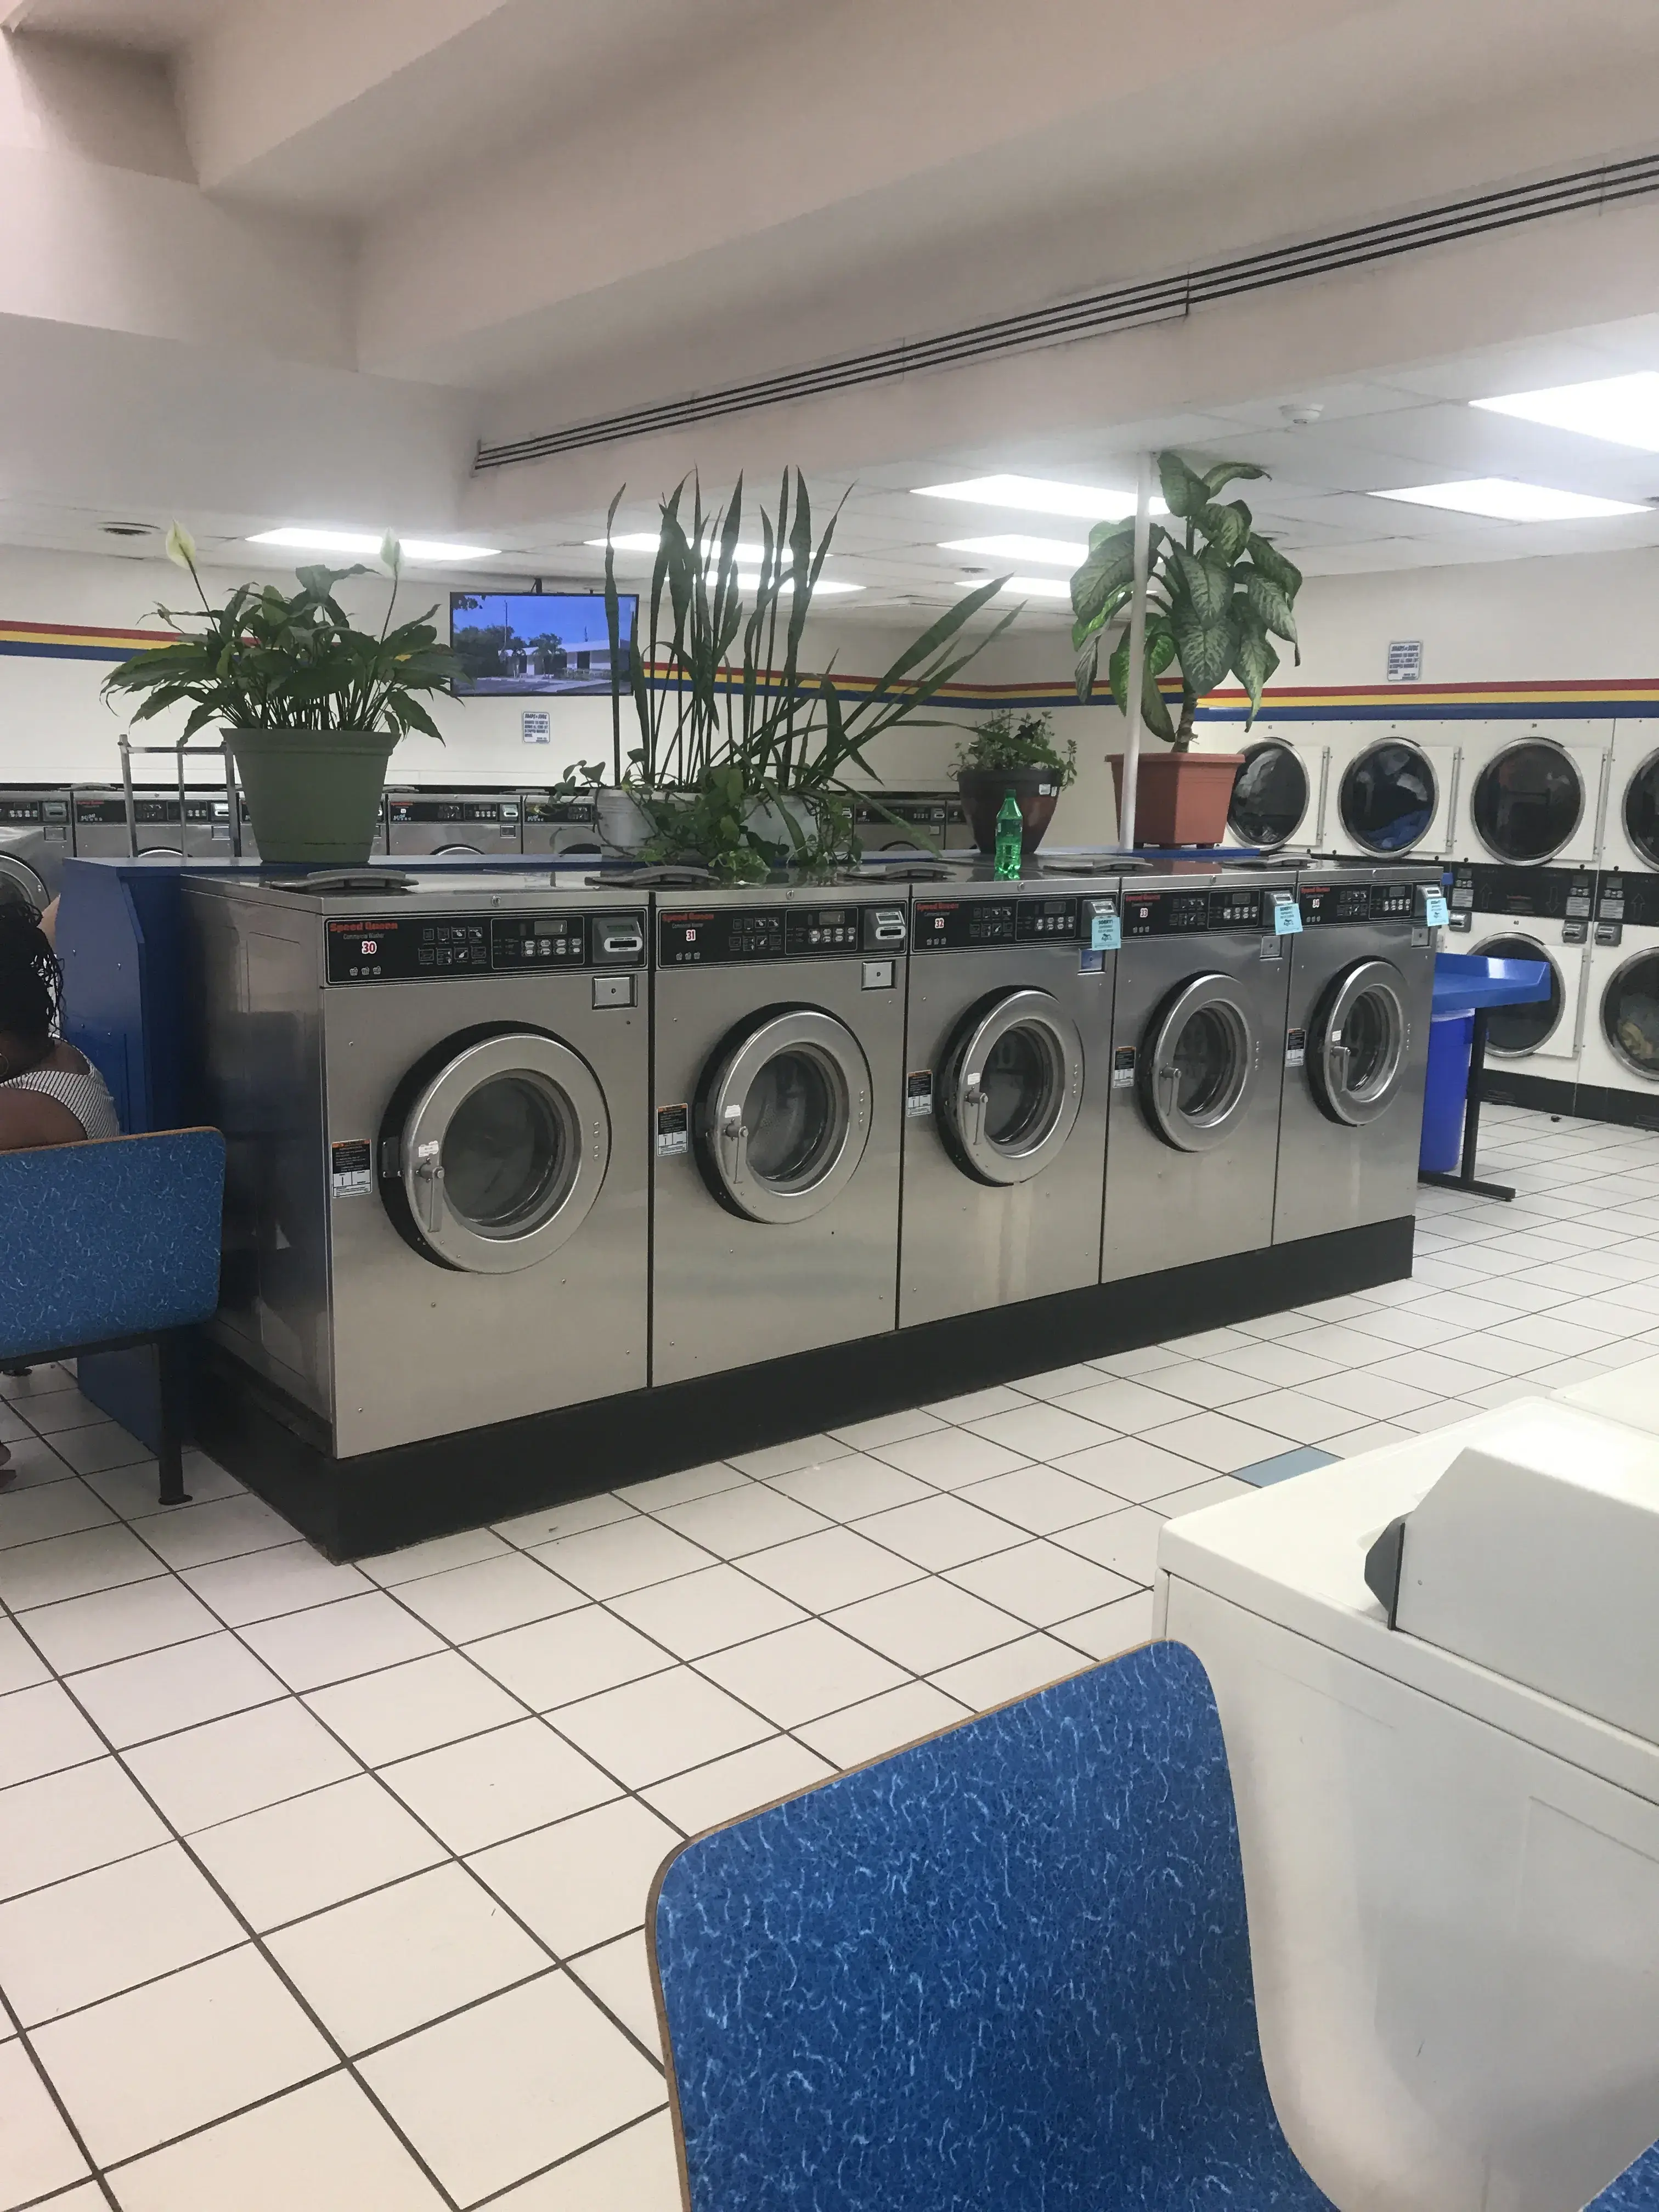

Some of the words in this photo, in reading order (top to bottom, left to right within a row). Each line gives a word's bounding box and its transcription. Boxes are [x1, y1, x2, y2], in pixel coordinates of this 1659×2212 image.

[1141, 909, 1148, 917] 33
[330, 922, 363, 933] Speed
[935, 918, 944, 928] 32
[687, 930, 695, 940] 31
[363, 942, 376, 953] 30
